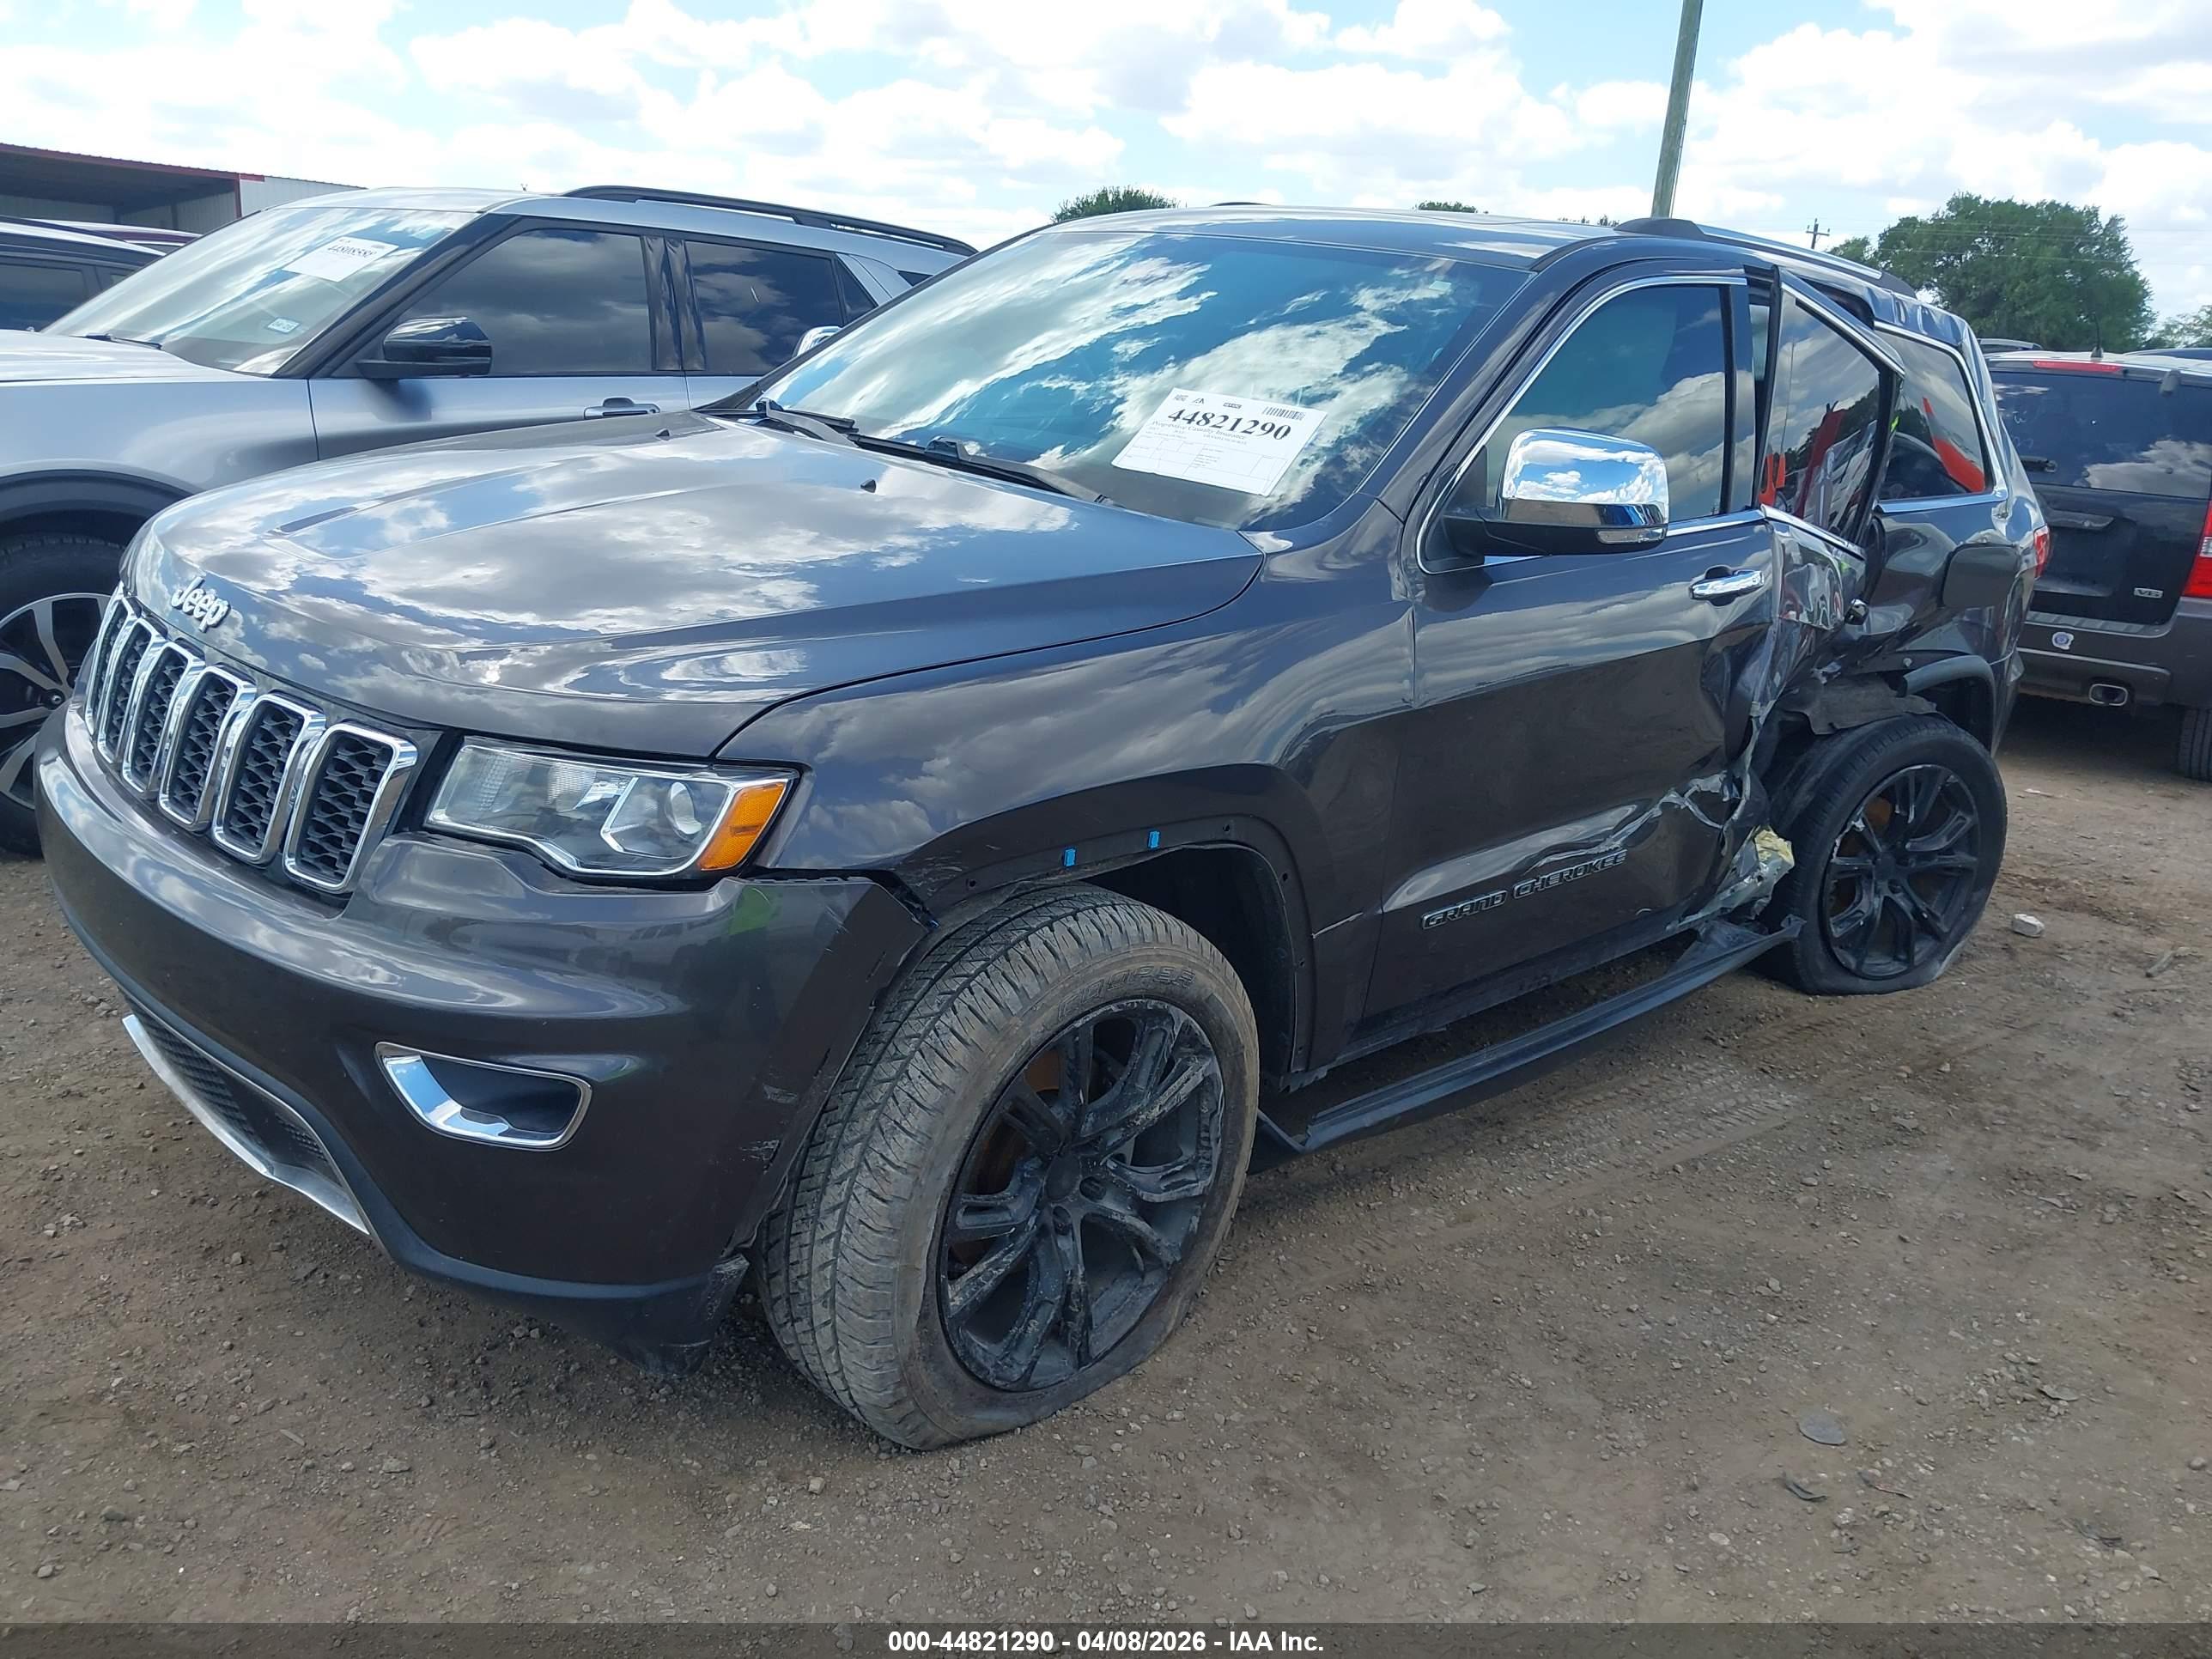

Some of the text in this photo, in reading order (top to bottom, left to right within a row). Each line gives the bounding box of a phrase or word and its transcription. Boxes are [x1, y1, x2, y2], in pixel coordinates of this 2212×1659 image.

[1167, 408, 1291, 441] 44821290
[172, 576, 230, 633] Jeep
[2136, 588, 2161, 598] V6
[1421, 849, 1628, 929] GRAND CHEROKEE
[1057, 965, 1196, 1021] COOPER
